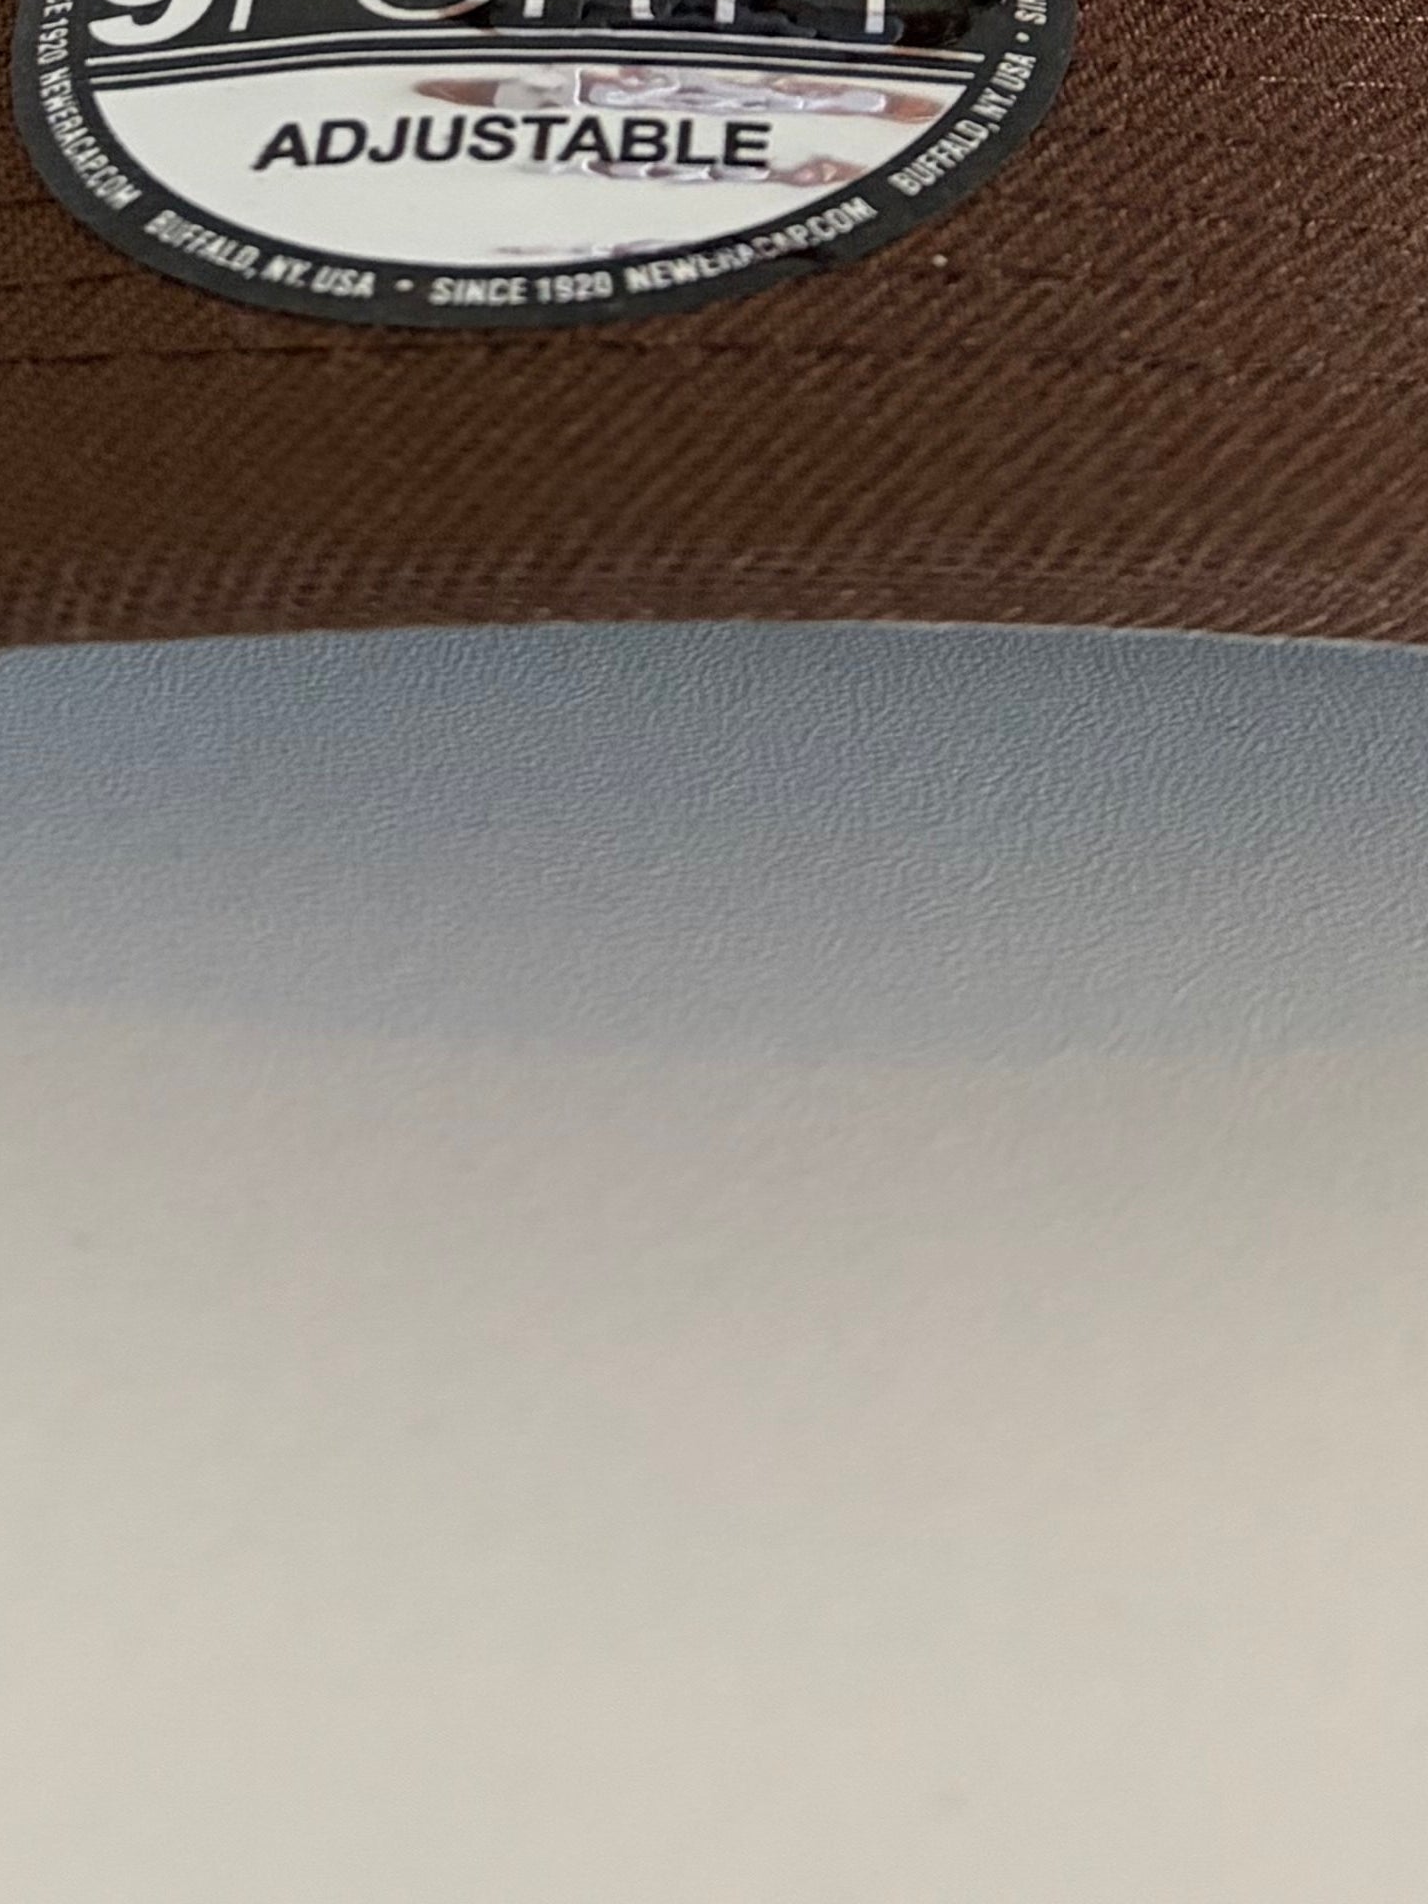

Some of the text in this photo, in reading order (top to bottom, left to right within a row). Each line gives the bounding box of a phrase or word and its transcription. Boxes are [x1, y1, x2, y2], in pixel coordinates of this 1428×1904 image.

[36, 18, 69, 66] 1920
[989, 51, 1037, 92] USA
[251, 114, 776, 172] ADJUSTABLE
[309, 265, 377, 300] USA
[427, 276, 529, 307] SINCE
[534, 270, 614, 305] 1920
